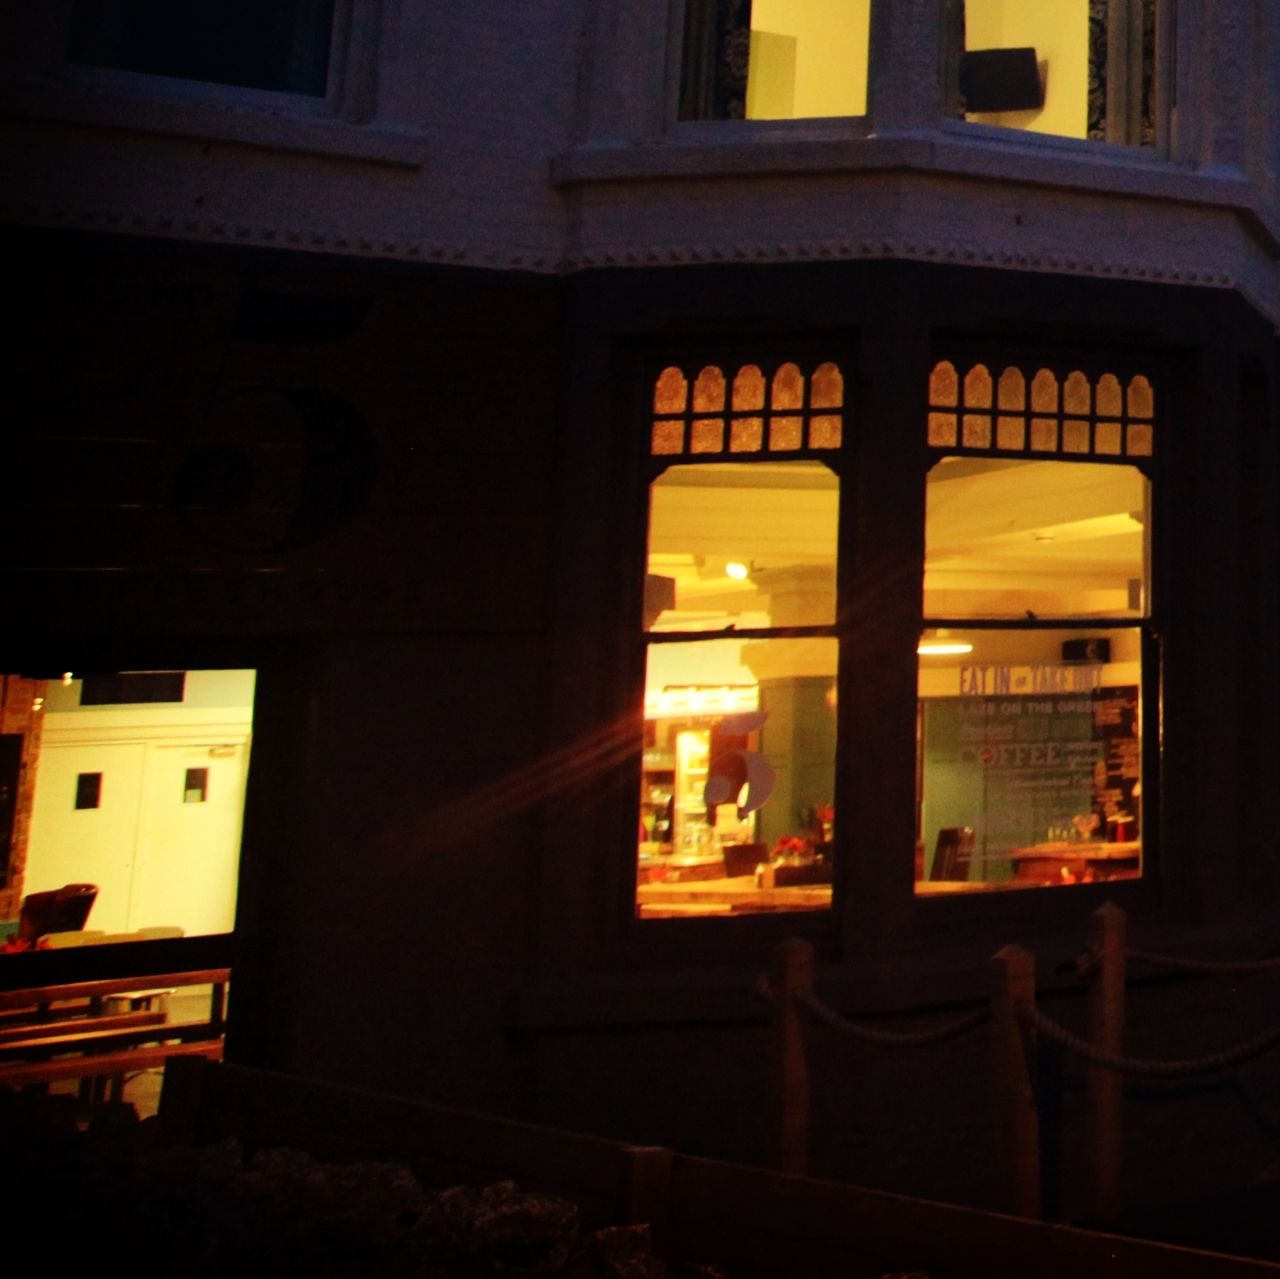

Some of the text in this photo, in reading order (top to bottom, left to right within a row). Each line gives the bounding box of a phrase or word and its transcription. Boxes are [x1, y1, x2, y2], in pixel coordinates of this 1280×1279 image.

[961, 667, 989, 696] EAT
[993, 666, 1010, 695] IN
[1000, 701, 1022, 715] ON
[1027, 701, 1053, 714] THE
[960, 742, 1061, 766] COFFEE
